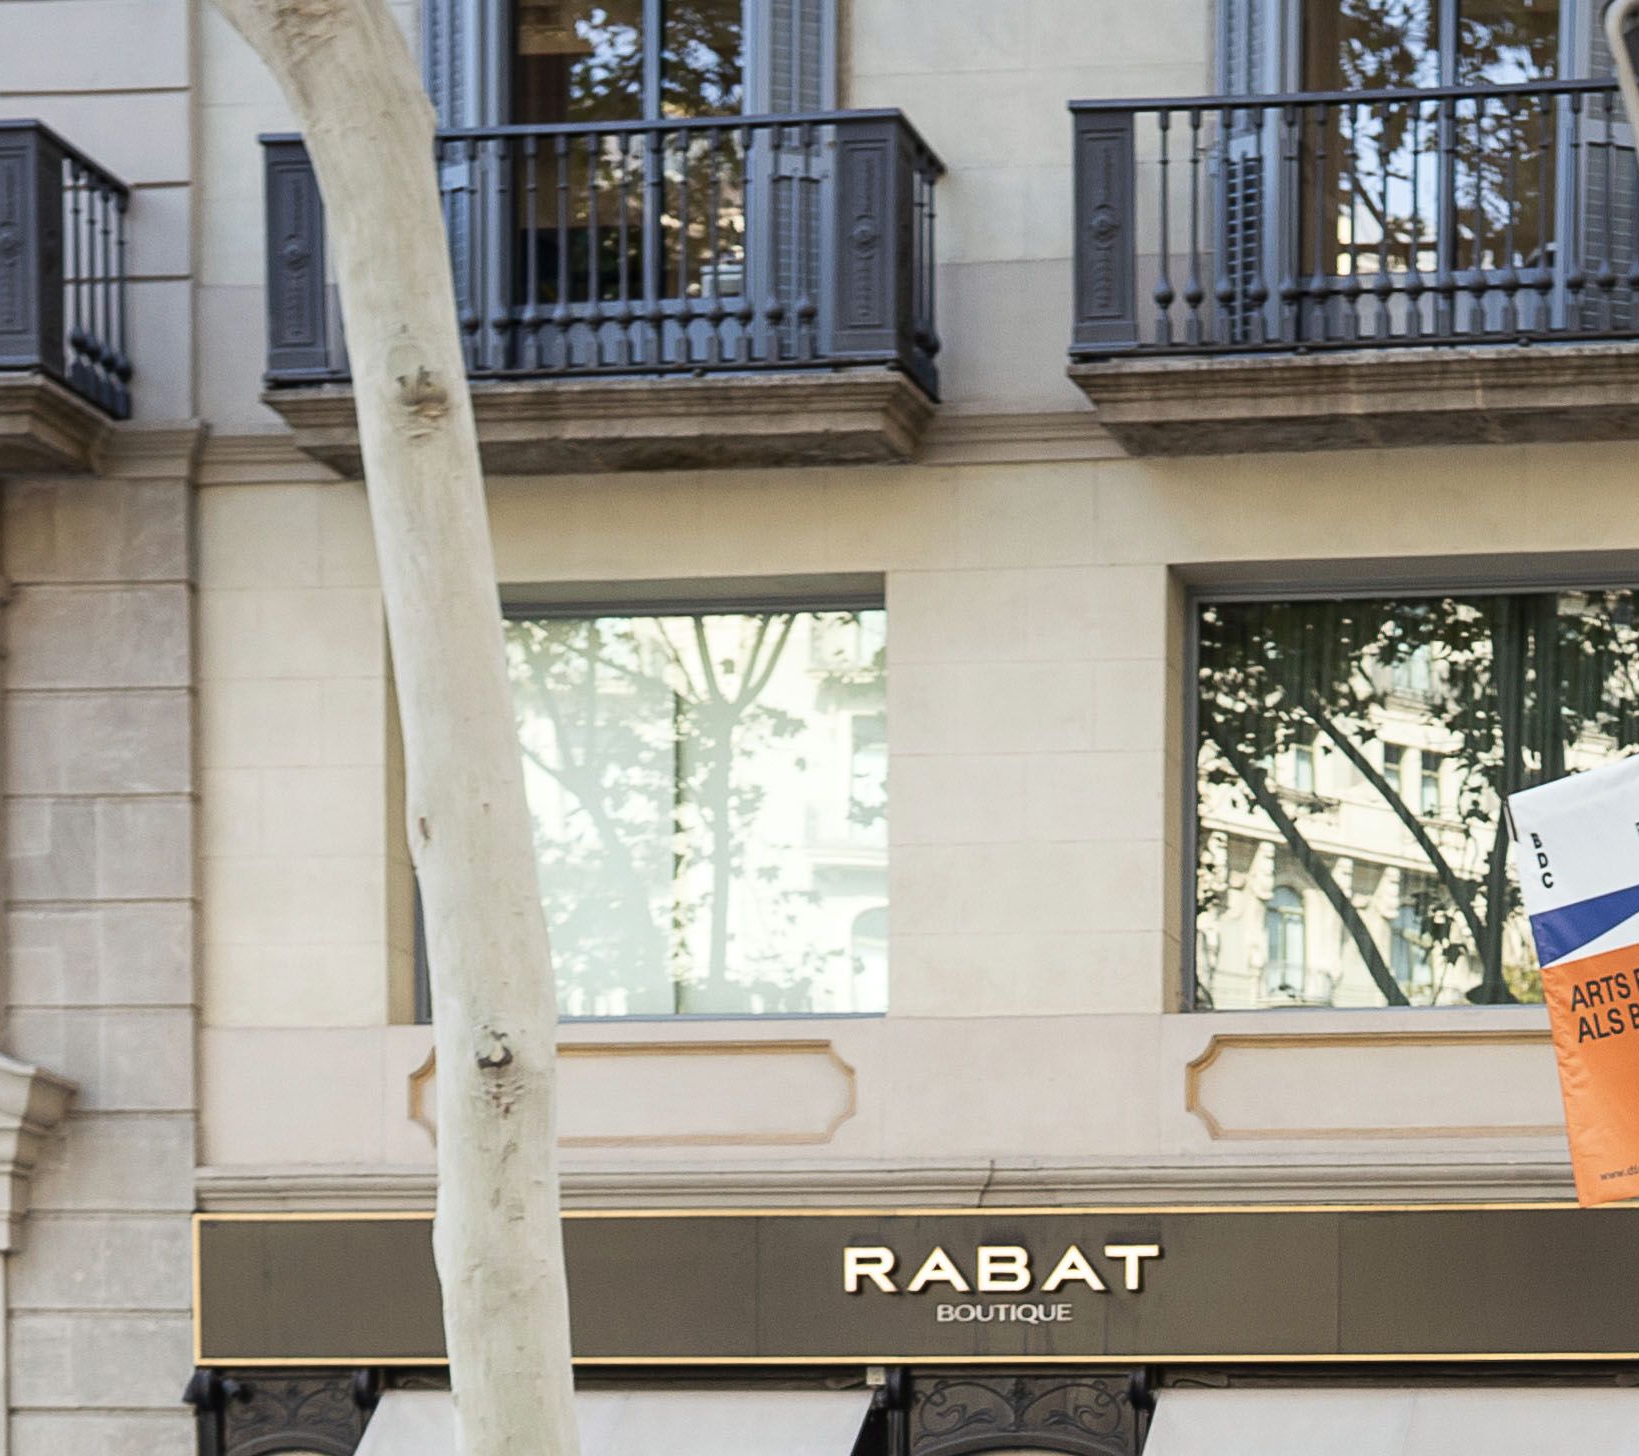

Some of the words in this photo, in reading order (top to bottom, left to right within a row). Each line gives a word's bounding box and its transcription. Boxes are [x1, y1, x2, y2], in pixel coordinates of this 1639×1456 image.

[1571, 973, 1631, 1012] ARTS
[1578, 1008, 1625, 1043] ALS
[844, 1244, 1160, 1293] RABAT
[936, 1303, 1073, 1324] BOUTIQUE
